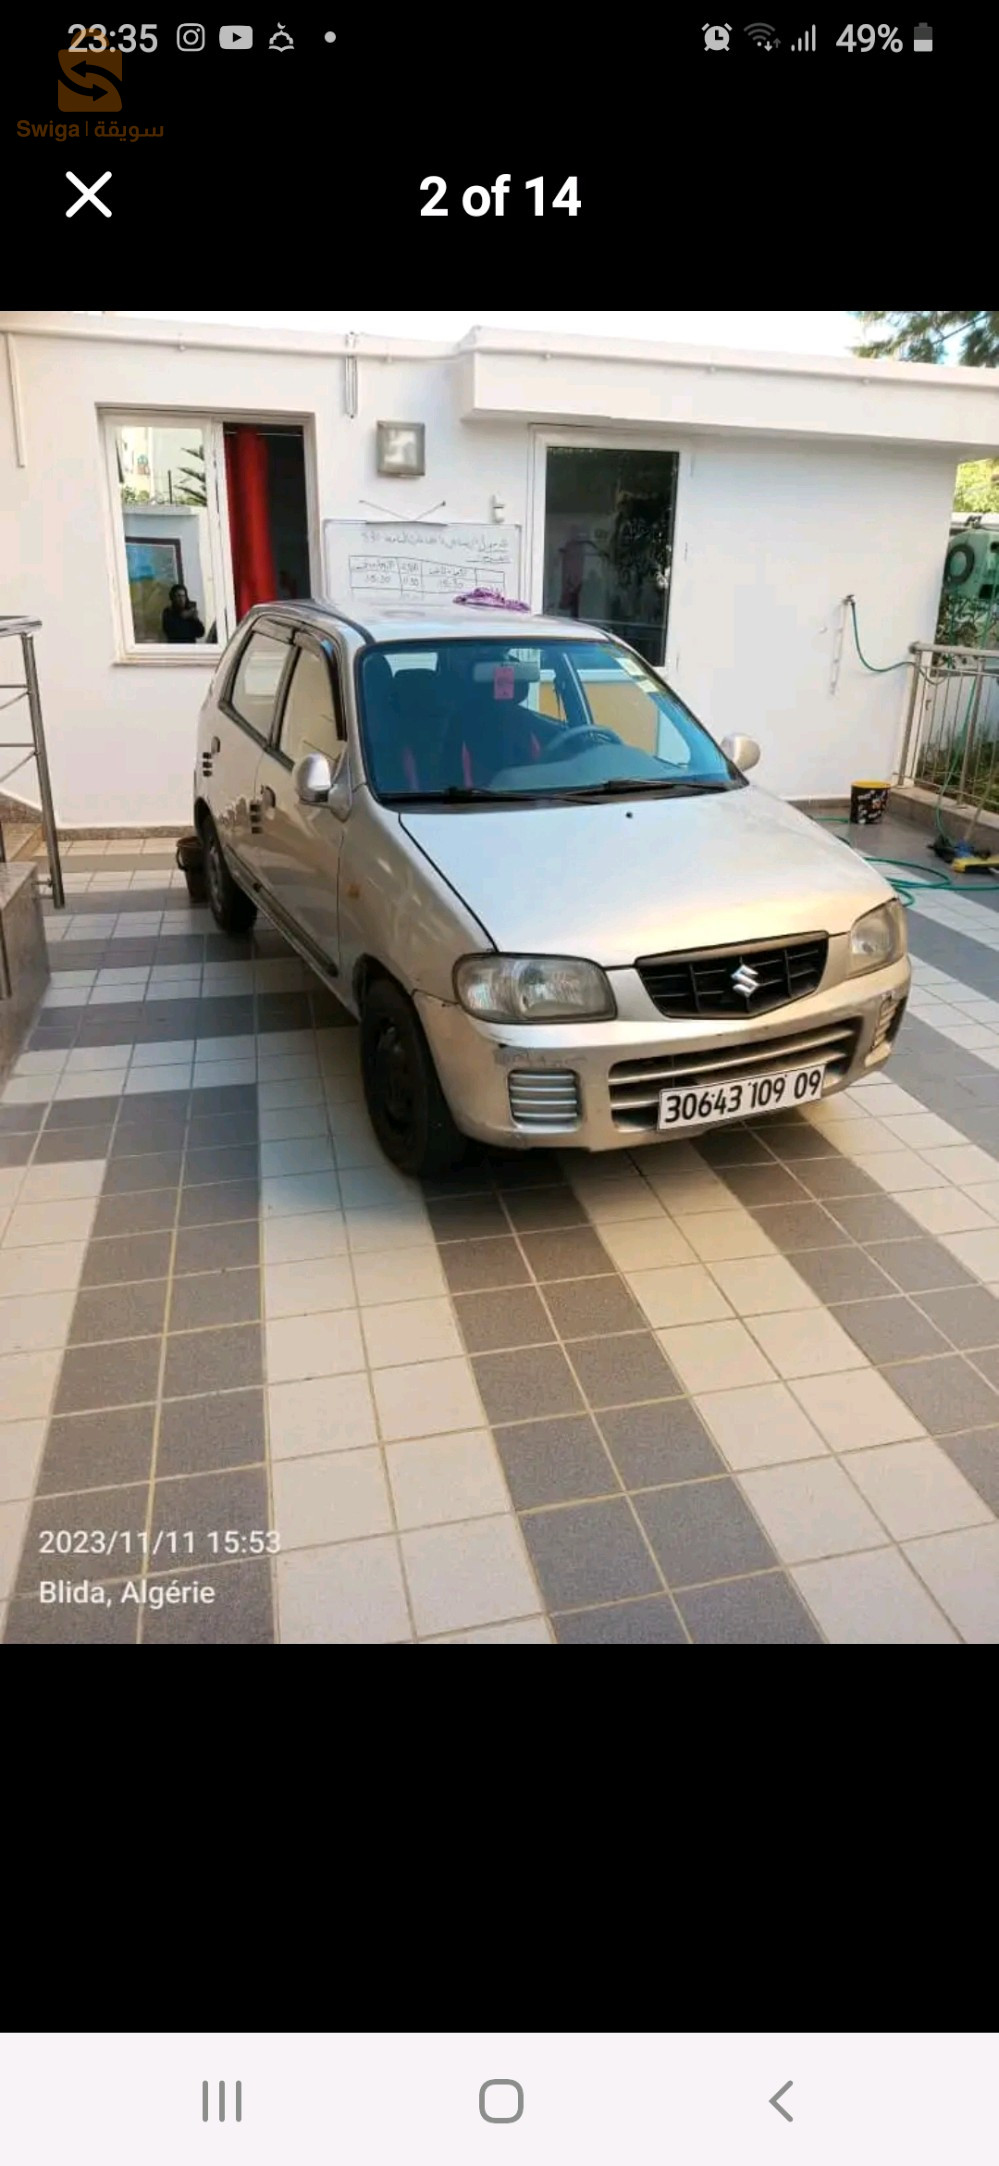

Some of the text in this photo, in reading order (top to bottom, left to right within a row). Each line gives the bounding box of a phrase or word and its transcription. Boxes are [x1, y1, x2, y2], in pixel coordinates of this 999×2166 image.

[664, 1069, 822, 1123] 30643 109 09
